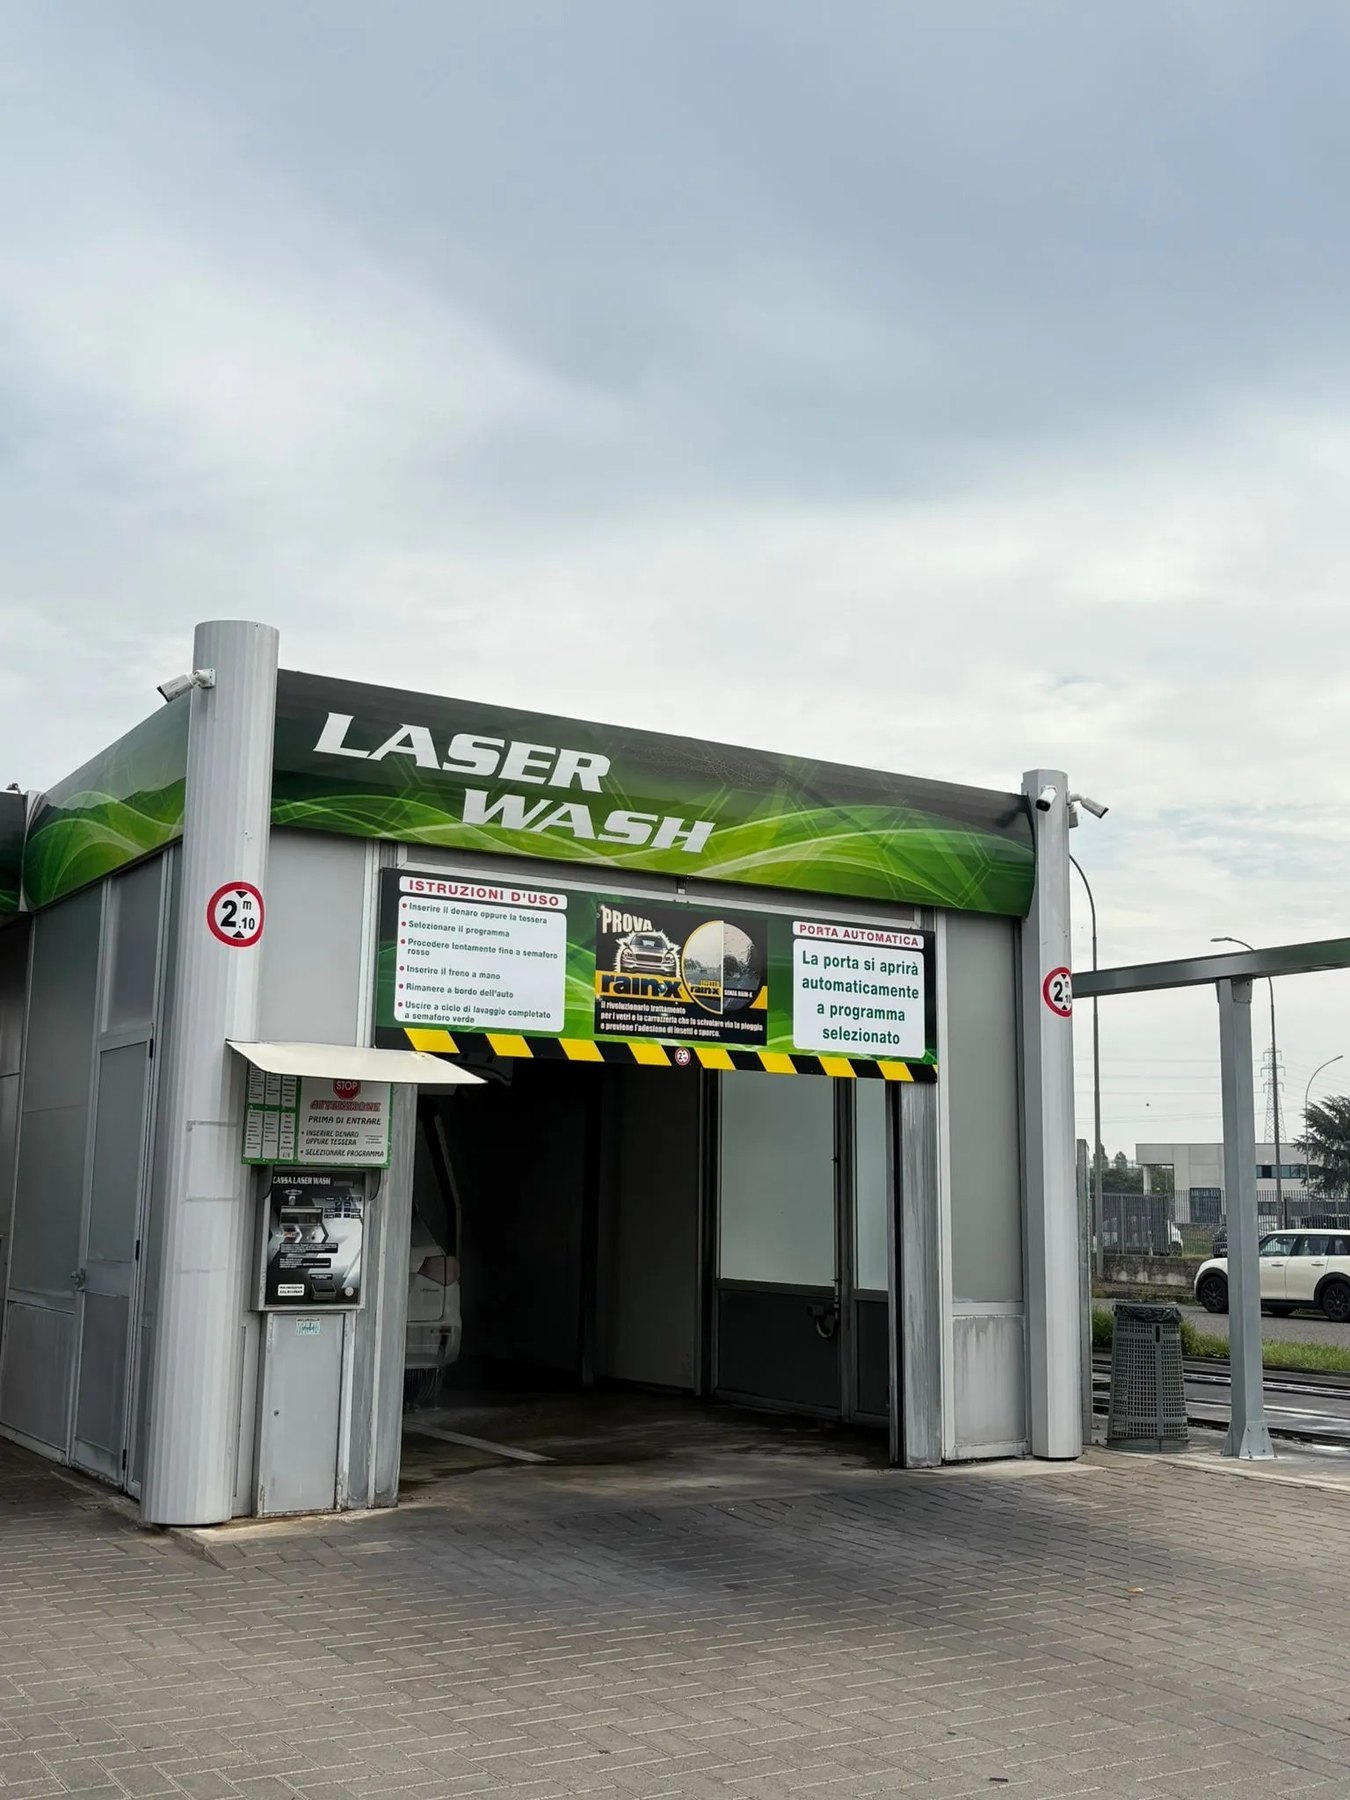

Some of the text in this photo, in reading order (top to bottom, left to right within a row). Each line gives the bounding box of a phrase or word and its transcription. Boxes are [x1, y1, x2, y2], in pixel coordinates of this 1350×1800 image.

[313, 712, 611, 793] LASER
[462, 788, 716, 853] WASH
[409, 880, 559, 906] ISTRUZIONI D'USO
[220, 900, 237, 928] 2
[242, 901, 252, 910] m
[409, 902, 440, 913] Inserire
[451, 908, 478, 916] denaro
[480, 910, 508, 920] oppure
[510, 912, 516, 920] la
[519, 914, 548, 924] tessera
[602, 908, 652, 933] PROVA
[408, 920, 456, 932] Selezionare
[466, 928, 510, 938] programma
[799, 924, 918, 946] PORTA AUTOMATICA
[408, 938, 449, 949] Procedere
[452, 942, 496, 954] lentamente
[523, 949, 558, 959] semaforo
[407, 965, 438, 975] Inserire
[802, 950, 918, 976] La porta si aprirà
[406, 983, 444, 993] Rimanere
[454, 987, 478, 996] bordo
[480, 989, 514, 998] dell'auto
[802, 977, 919, 999] automaticamente
[1054, 981, 1063, 1002] 2
[405, 1001, 431, 1010] Uscire
[441, 1004, 461, 1012] ciclo
[473, 1006, 506, 1016] lavaggio
[508, 1009, 551, 1019] completato
[607, 1002, 649, 1011] rivoluzionario
[651, 1005, 686, 1014] trattamento
[817, 1003, 905, 1021] a programma
[412, 1013, 450, 1022] semaforo
[452, 1015, 475, 1023] verde
[644, 1015, 677, 1024] carrozzeria
[697, 1018, 723, 1027] scivolare
[741, 1022, 763, 1031] pioggia
[606, 1023, 633, 1031] previene
[634, 1024, 666, 1033] l'adesione
[674, 1026, 693, 1035] insetti
[823, 1026, 900, 1045] selezionato
[336, 1080, 358, 1090] STOP
[346, 1117, 381, 1125] ENTRARE
[273, 1176, 292, 1184] CASSA
[293, 1176, 312, 1184] LASER
